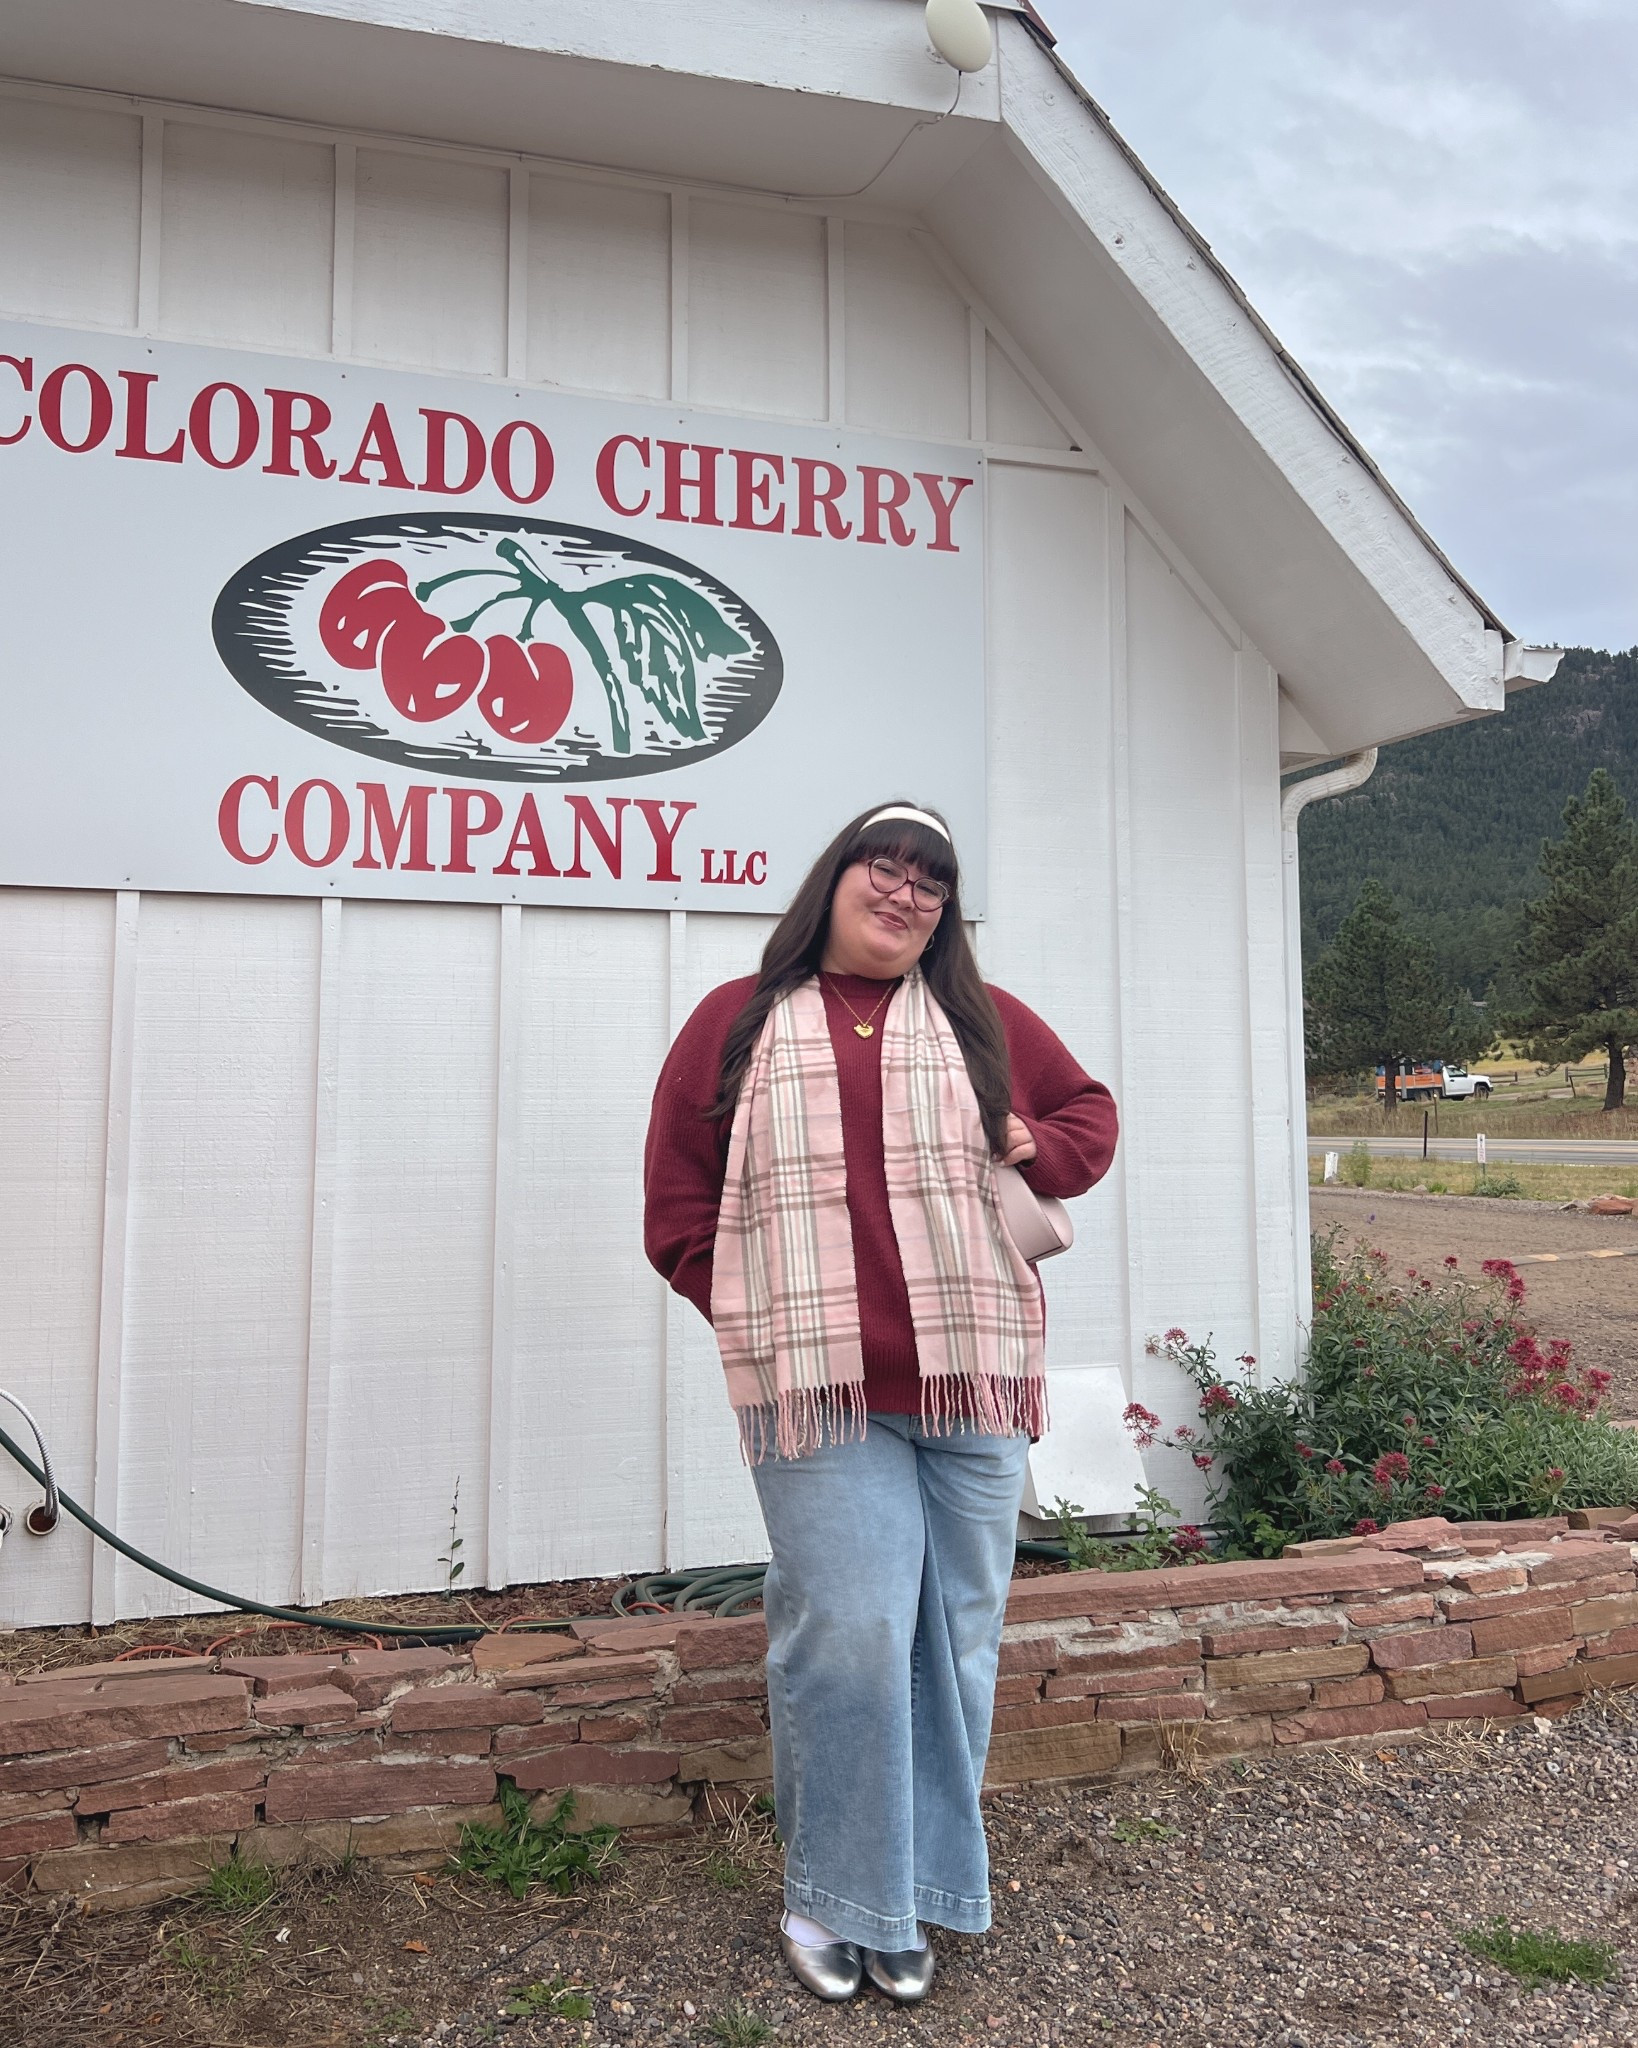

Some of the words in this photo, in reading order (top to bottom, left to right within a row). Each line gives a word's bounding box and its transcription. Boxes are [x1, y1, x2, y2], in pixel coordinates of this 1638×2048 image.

[596, 434, 974, 553] CHERRY
[218, 775, 697, 883] COMPANY
[701, 848, 768, 886] LLC
